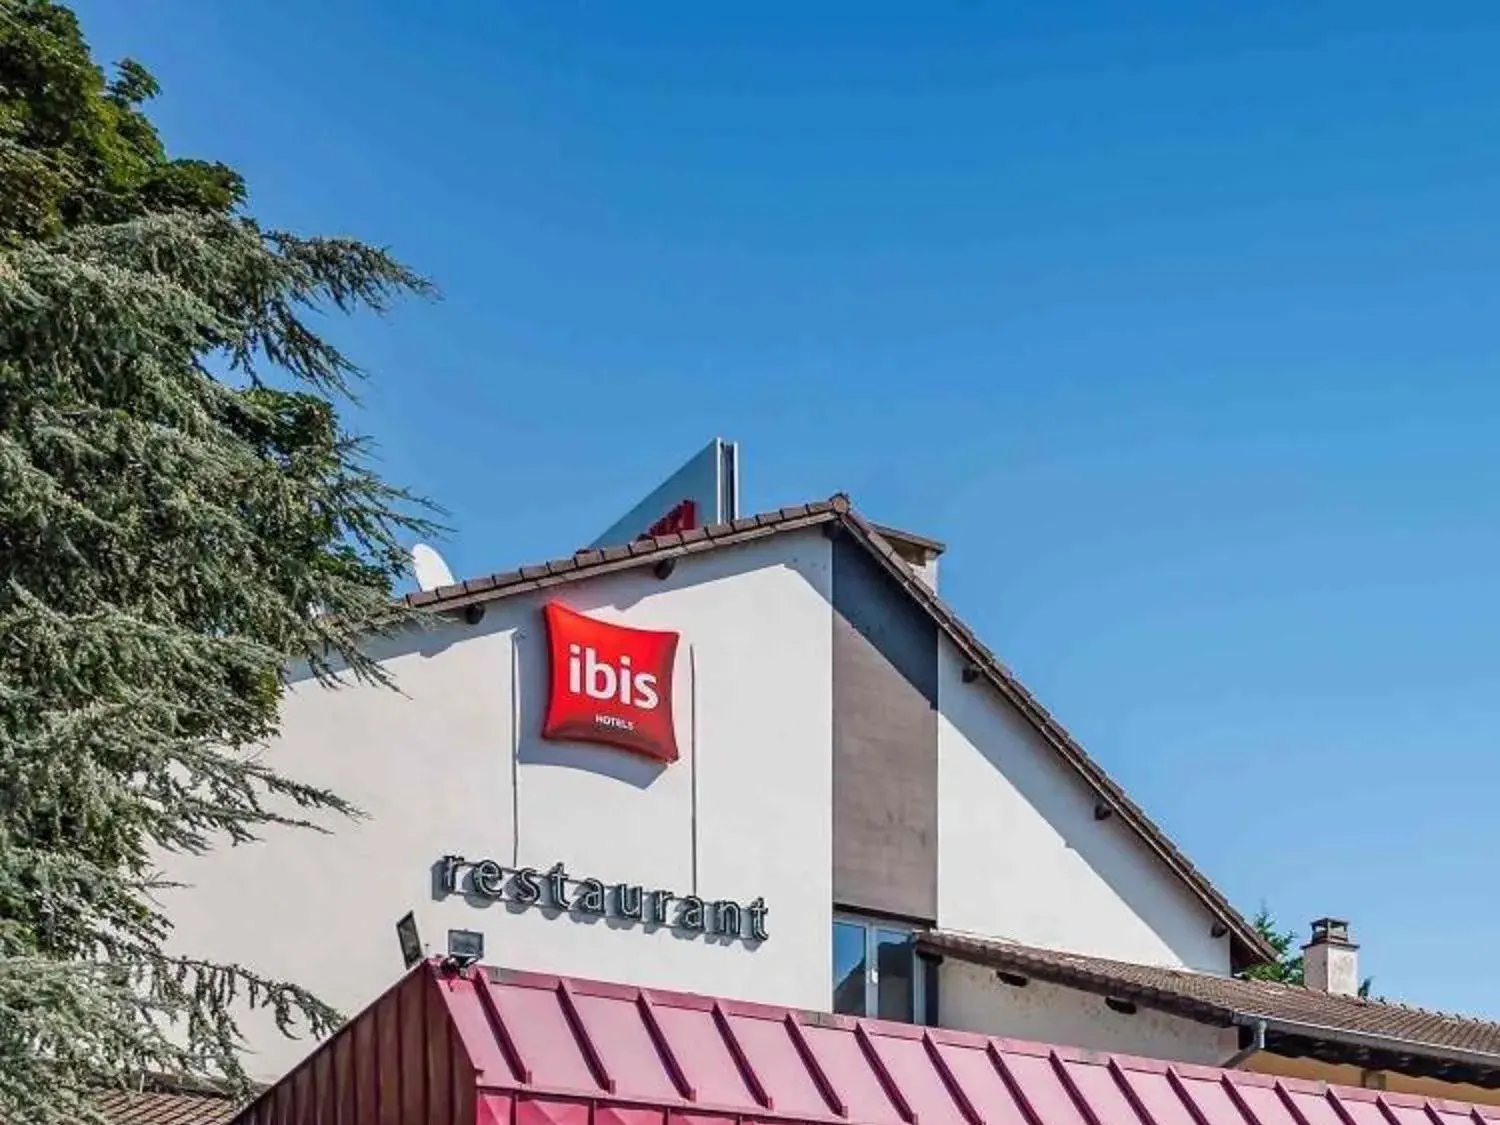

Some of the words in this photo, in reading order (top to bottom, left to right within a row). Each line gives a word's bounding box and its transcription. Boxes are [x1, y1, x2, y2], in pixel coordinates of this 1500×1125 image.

[568, 642, 660, 710] ibis
[594, 713, 635, 731] HOTELS
[442, 854, 769, 941] restaurant
